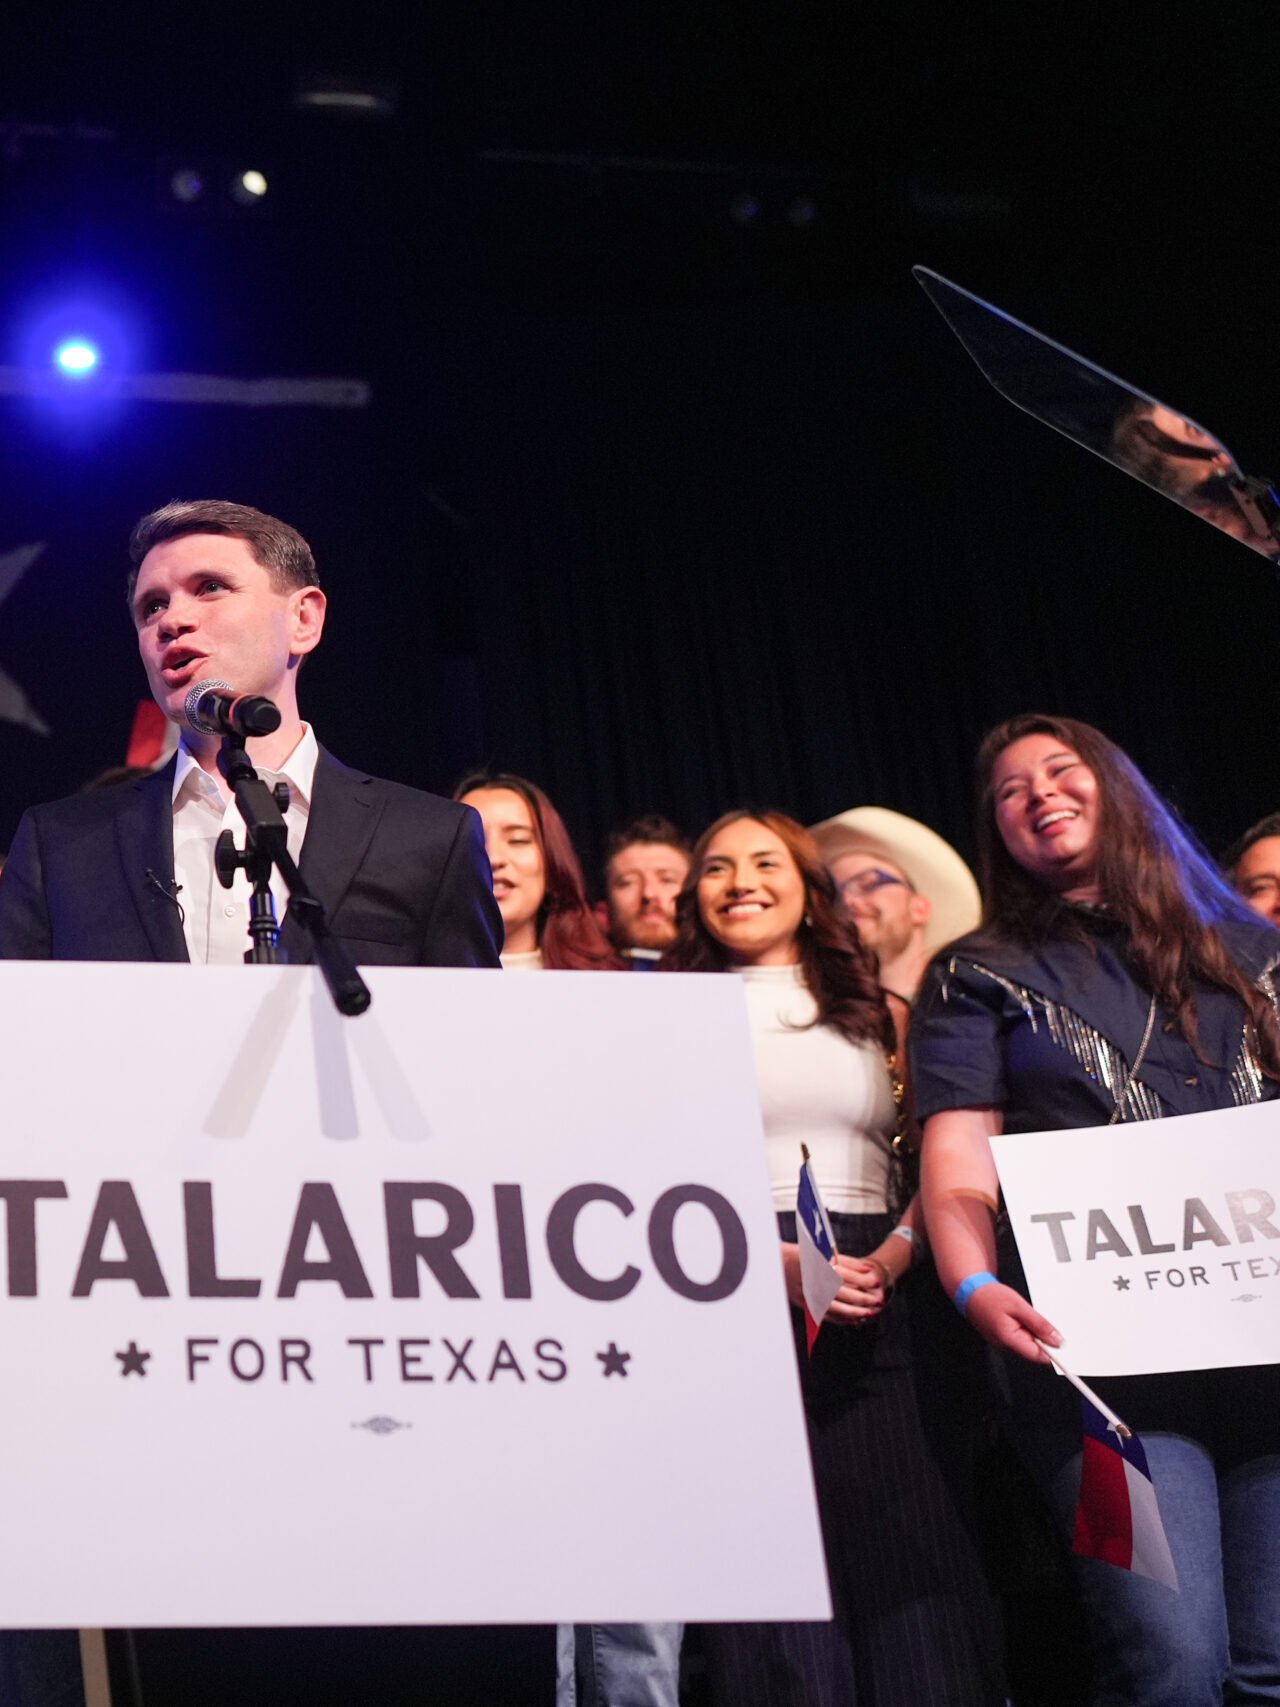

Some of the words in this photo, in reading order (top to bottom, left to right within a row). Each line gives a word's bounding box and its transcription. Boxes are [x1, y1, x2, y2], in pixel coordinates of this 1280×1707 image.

[1030, 1188, 1280, 1264] TALAR
[1144, 1265, 1210, 1291] FOR
[186, 1337, 314, 1383] FOR
[347, 1337, 568, 1383] TEXAS
